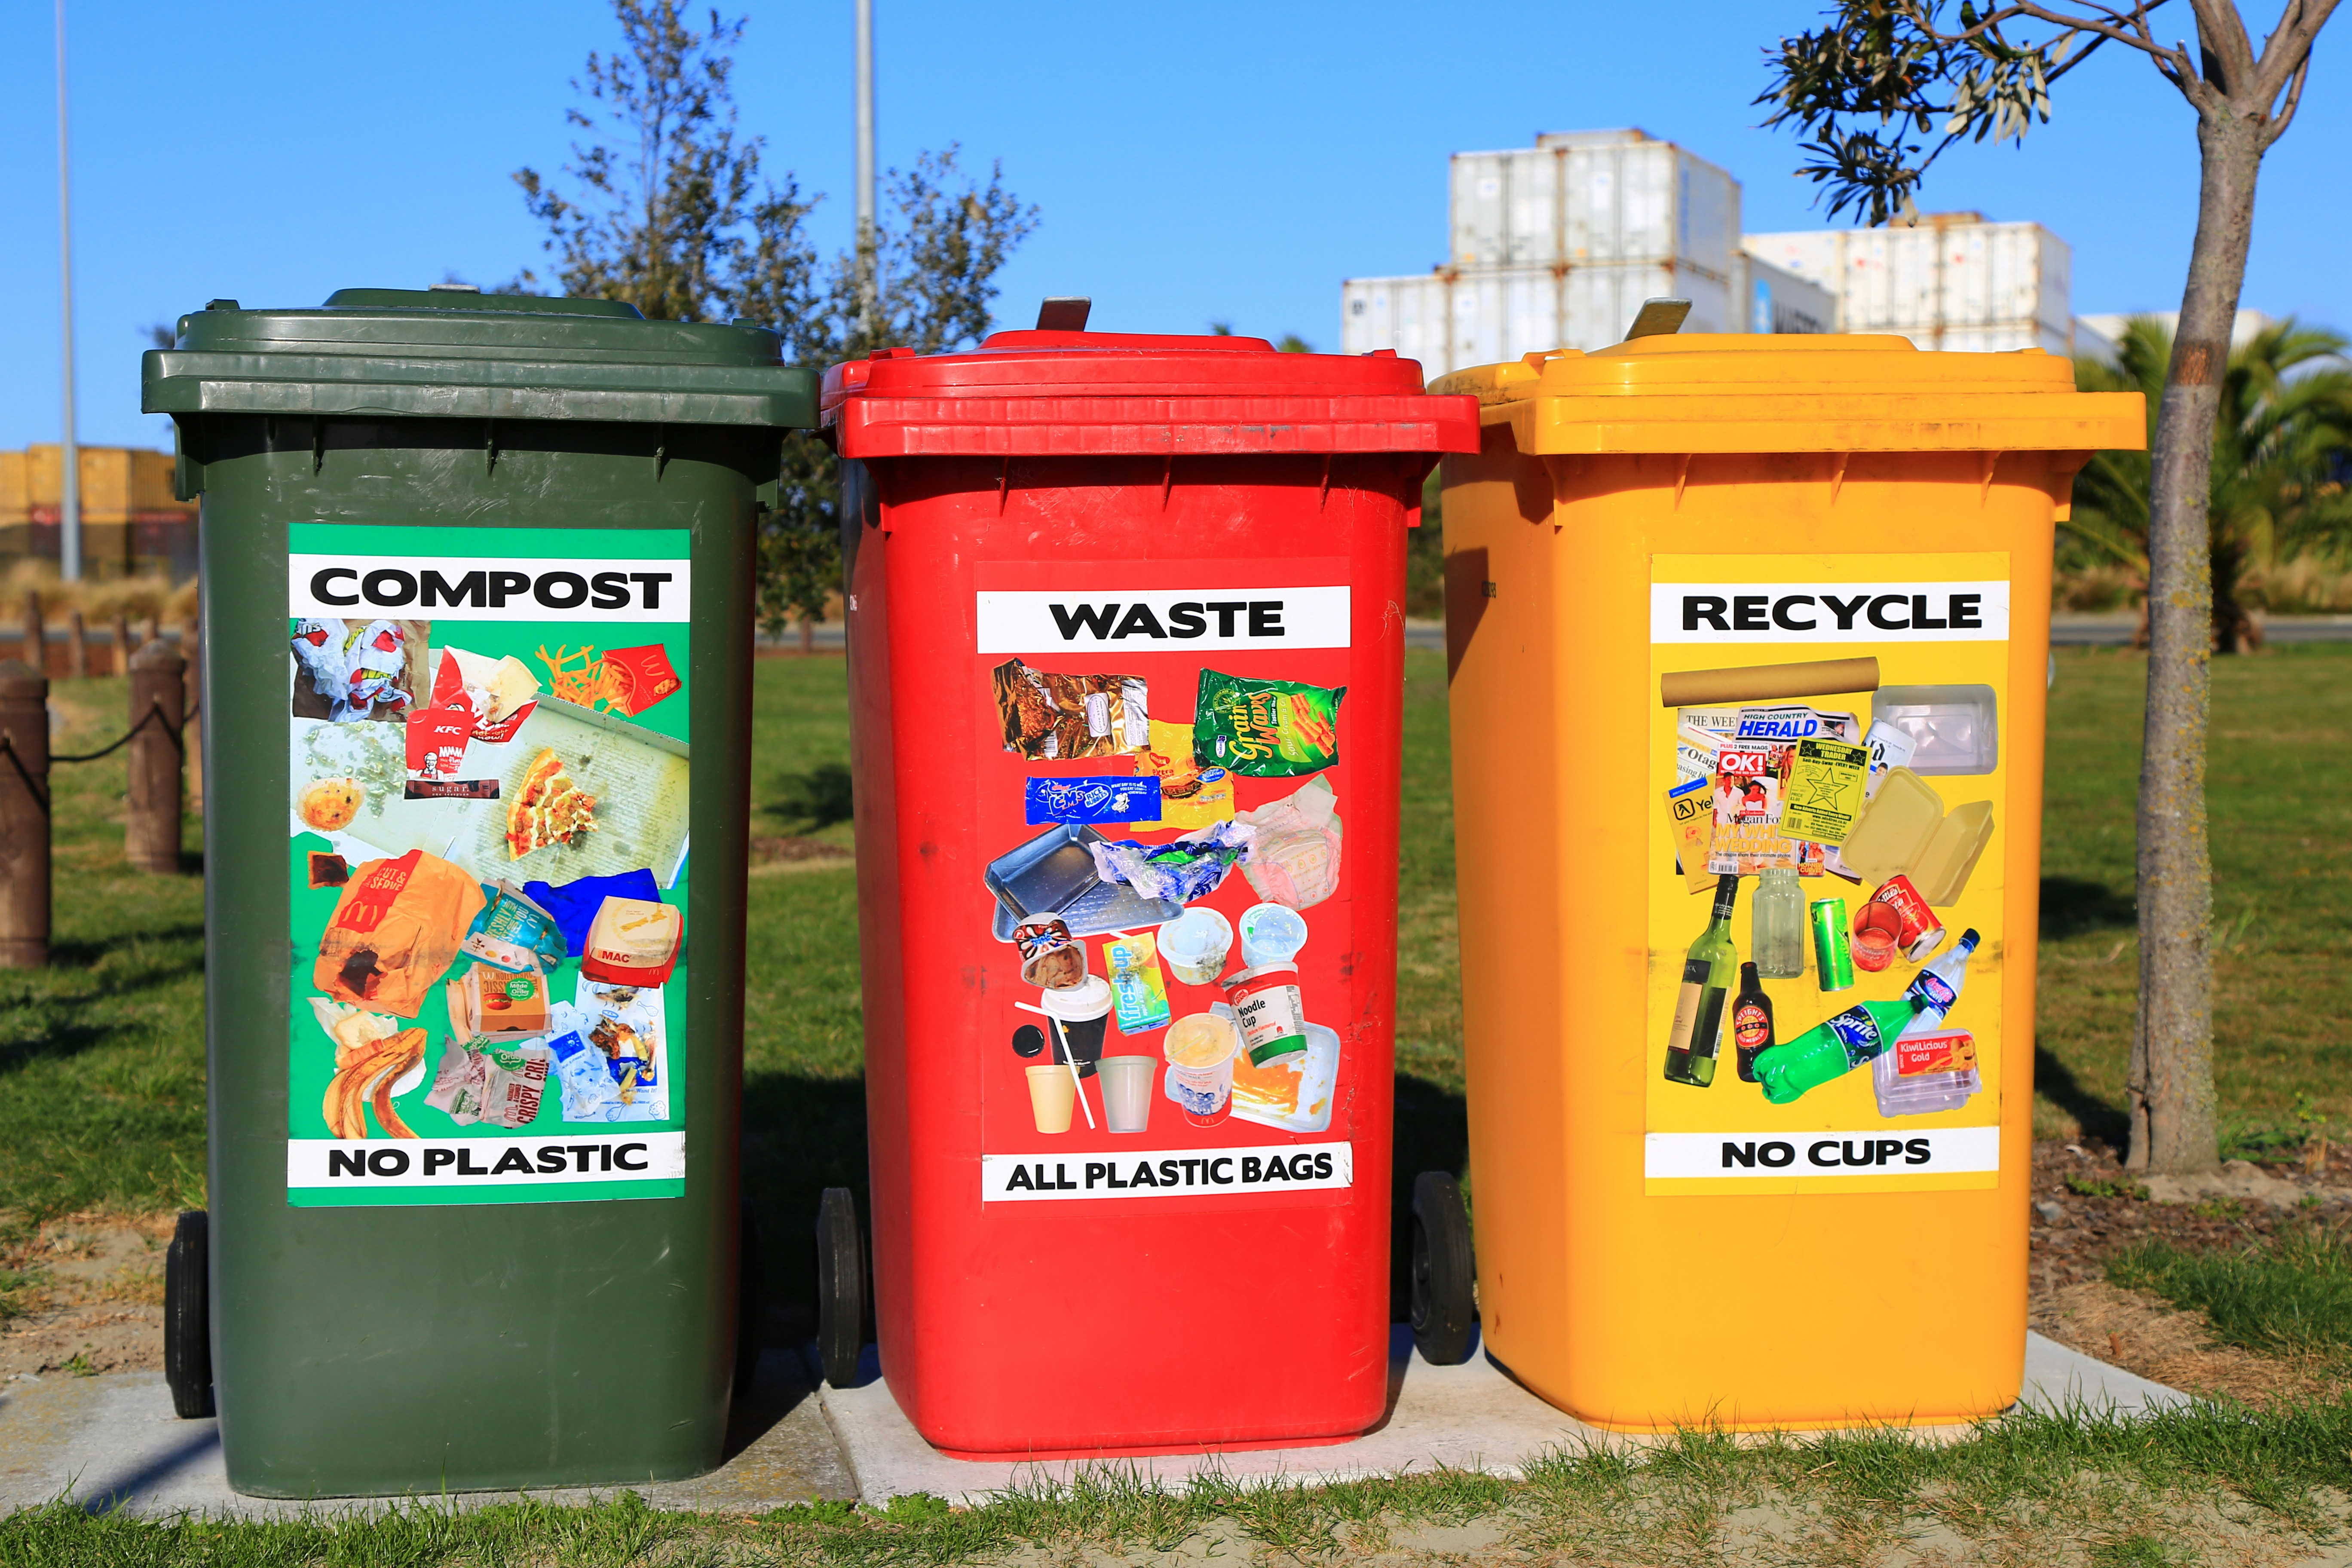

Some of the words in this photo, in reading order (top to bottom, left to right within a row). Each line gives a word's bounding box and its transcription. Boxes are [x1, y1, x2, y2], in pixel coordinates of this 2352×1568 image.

[310, 568, 672, 609] COMPOST
[1049, 601, 1285, 640] WASTE
[1683, 594, 1982, 631] RECYCLE
[1248, 692, 1281, 759] Waves
[1686, 715, 1708, 727] THE
[1738, 719, 1818, 738] HERALD
[434, 726, 462, 735] KFC
[1228, 704, 1258, 760] Grain
[1286, 738, 1299, 756] Sour
[1816, 743, 1853, 755] WEDNESDAY
[1821, 750, 1847, 760] TRADER
[1721, 753, 1764, 772] OK!
[1085, 791, 1108, 806] BUBBLES
[1087, 787, 1103, 799] RICE
[1715, 823, 1741, 838] MY
[1715, 838, 1792, 853] WEDDING
[512, 906, 529, 922] YOU
[602, 950, 629, 963] MAC
[1929, 990, 1943, 1004] zero
[1238, 999, 1266, 1018] Noodle
[1242, 1016, 1256, 1028] Cup
[1830, 1013, 1878, 1041] Sprite
[1901, 1041, 1948, 1053] KiwiLicious
[1911, 1052, 1930, 1063] Gold
[517, 1085, 541, 1124] CRISPY
[329, 1149, 410, 1177] NO
[423, 1143, 648, 1176] PLASTIC
[1722, 1141, 1795, 1167] NO
[1808, 1139, 1931, 1167] CUPS
[1006, 1163, 1077, 1191] ALL
[1086, 1158, 1233, 1189] PLASTIC
[1242, 1152, 1332, 1183] BAGS
